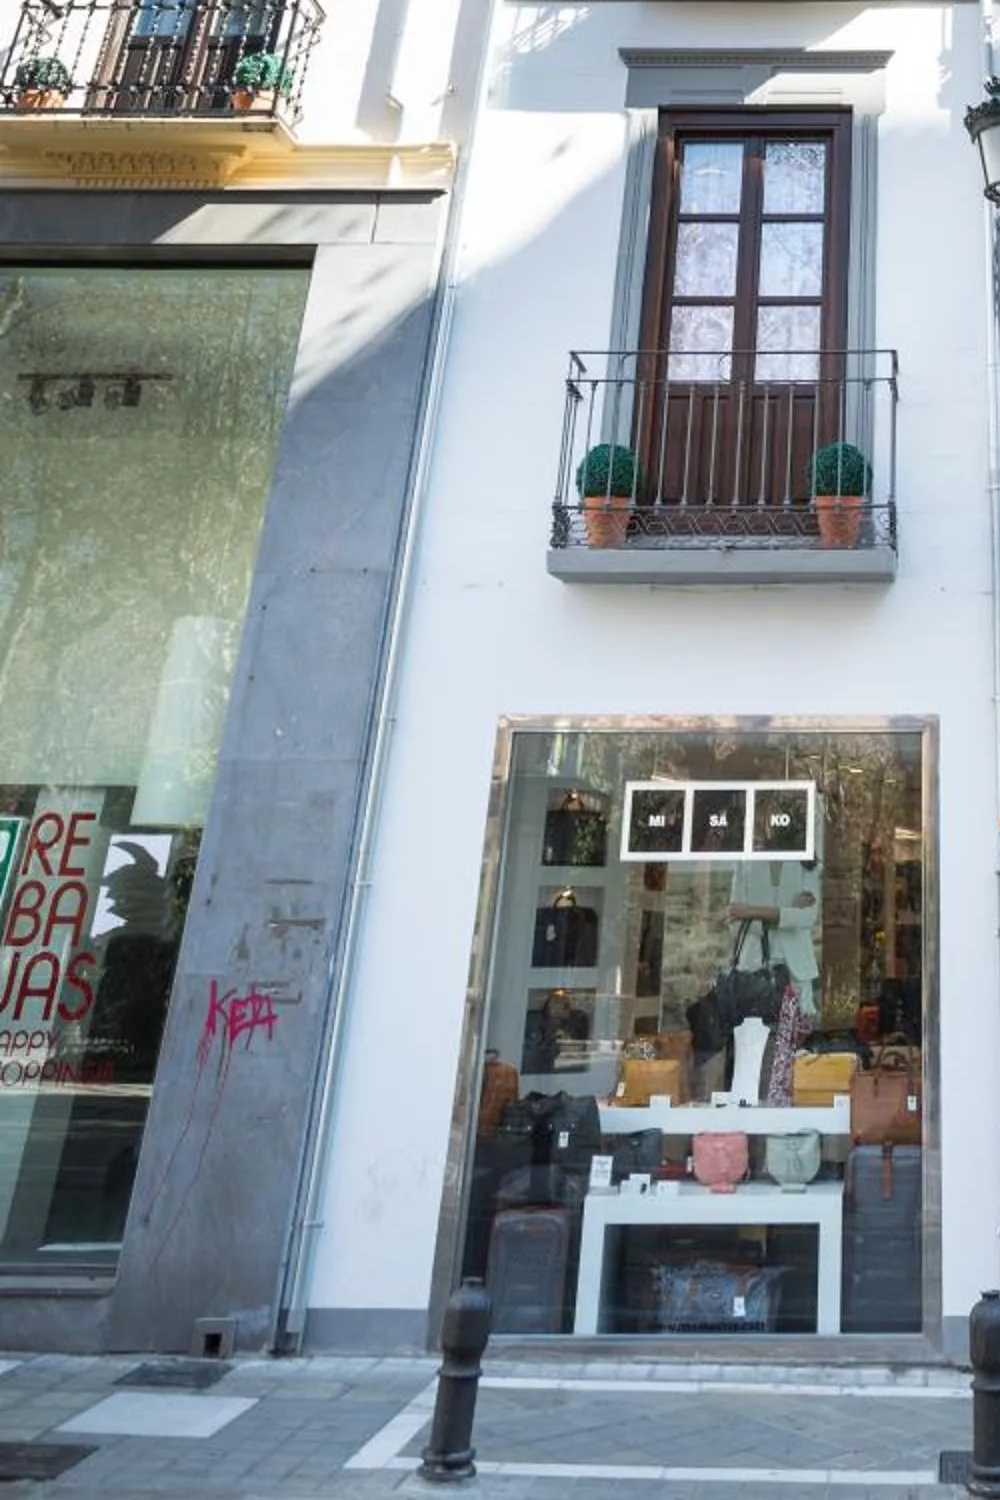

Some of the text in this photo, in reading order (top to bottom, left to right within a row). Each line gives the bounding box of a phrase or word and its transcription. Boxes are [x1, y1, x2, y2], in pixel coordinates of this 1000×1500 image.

[21, 812, 97, 877] RE
[649, 813, 791, 827] MI SA KO
[4, 880, 89, 947] BA
[0, 951, 97, 1023] JAS
